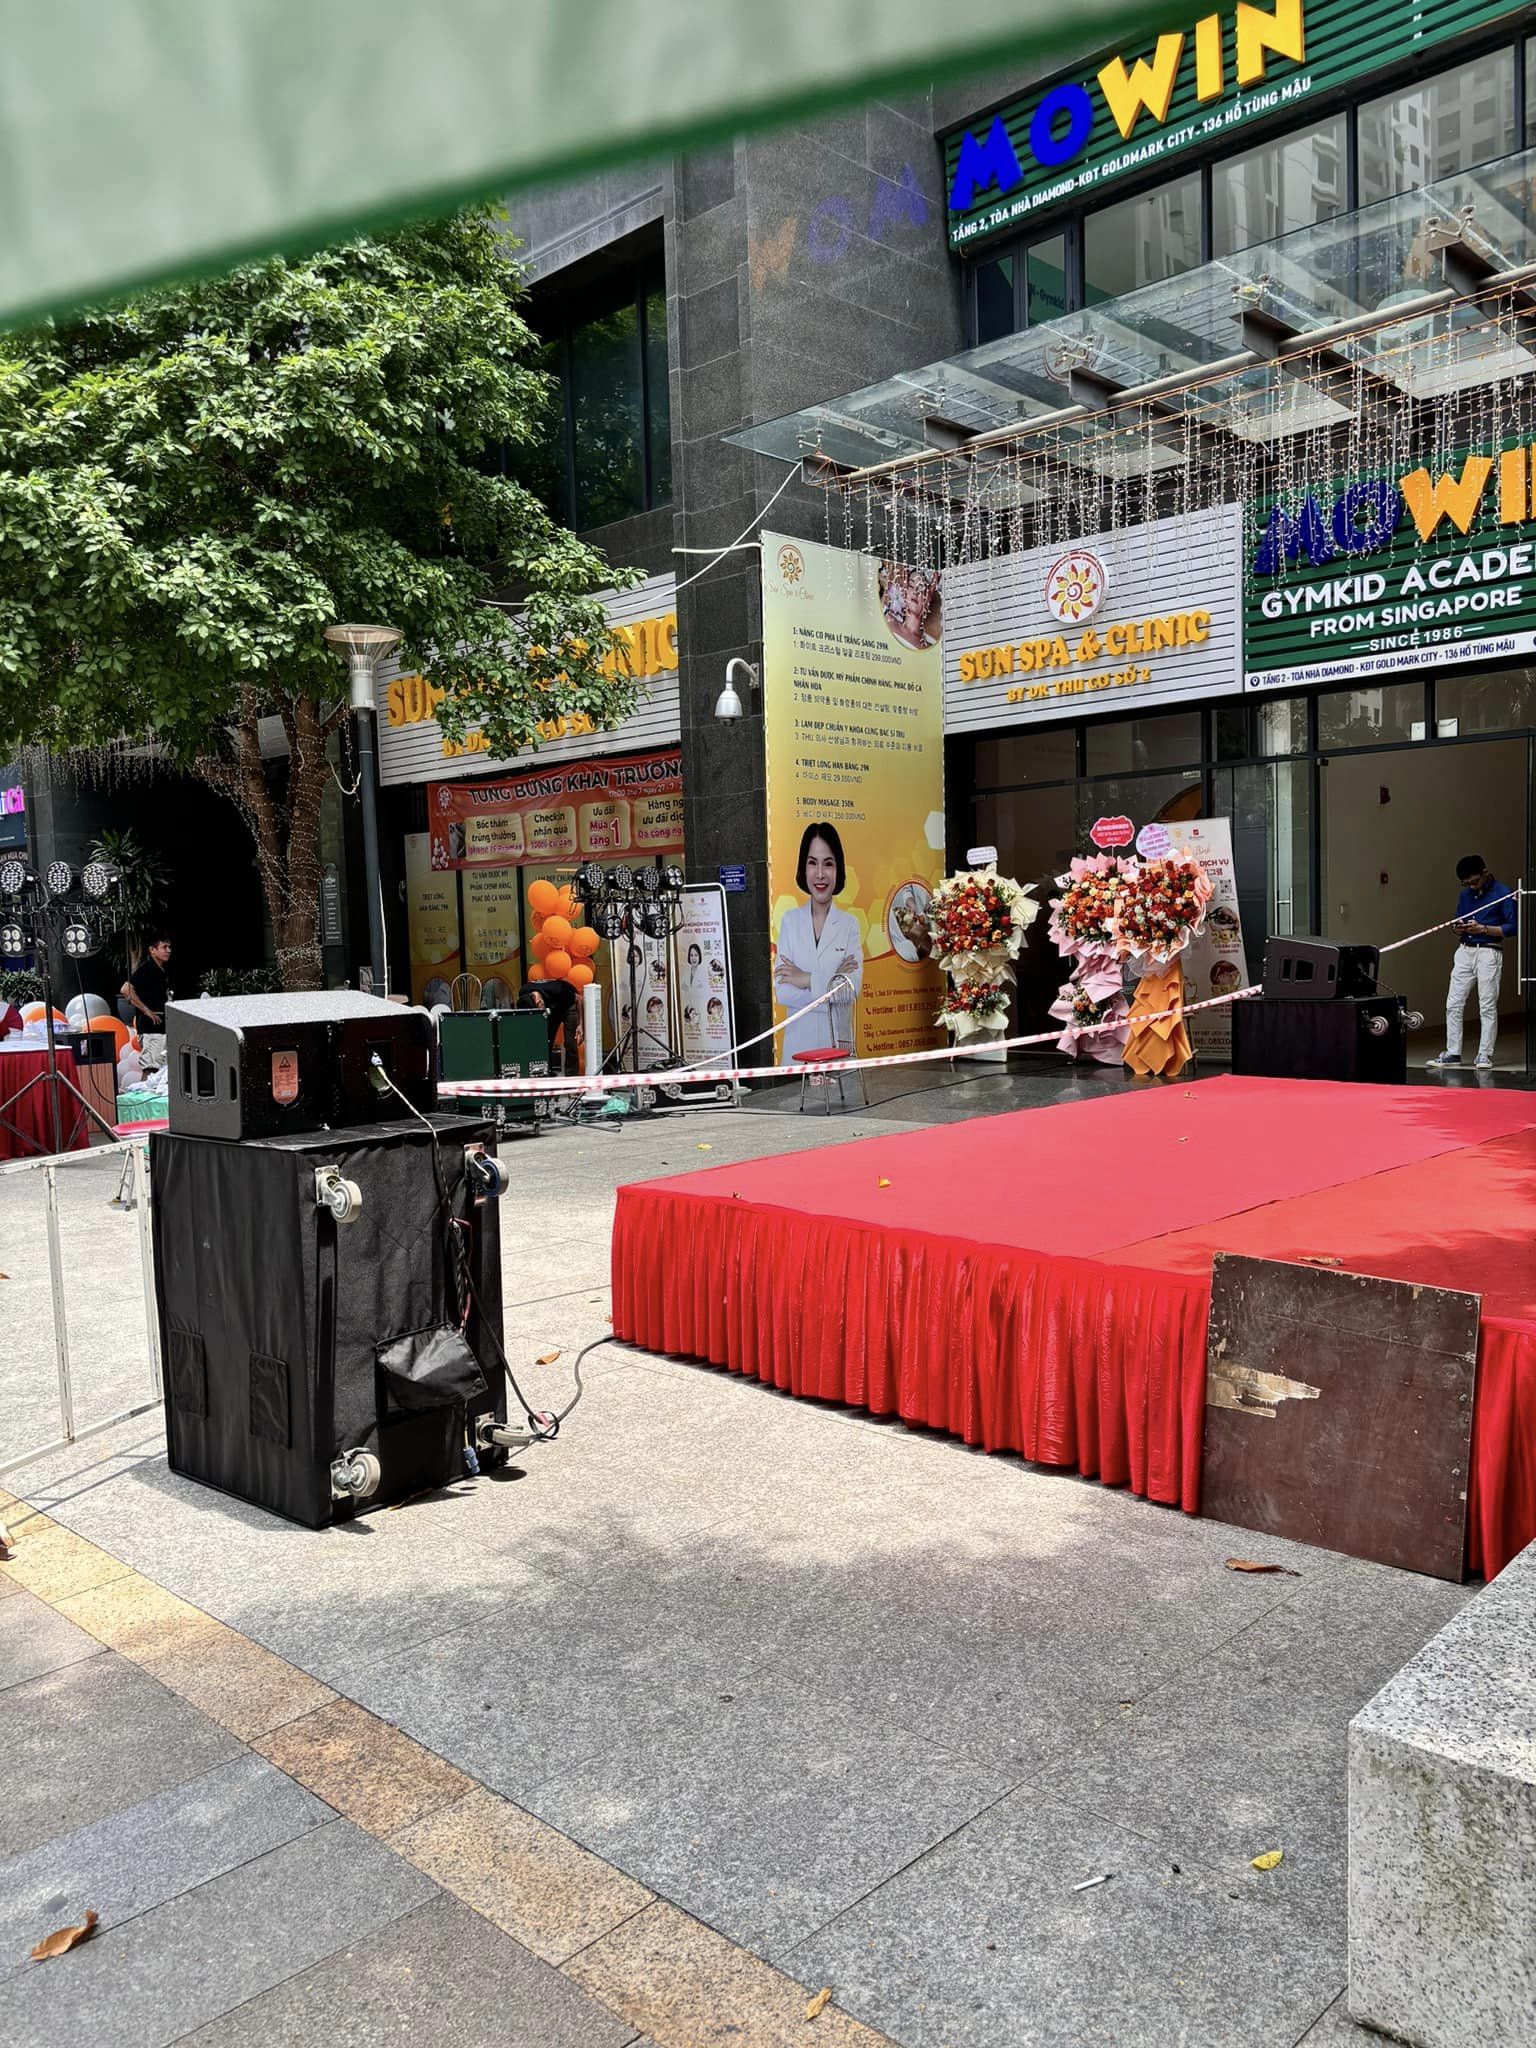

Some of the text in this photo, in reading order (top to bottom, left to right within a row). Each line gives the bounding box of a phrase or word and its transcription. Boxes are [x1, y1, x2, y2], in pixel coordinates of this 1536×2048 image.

[950, 0, 1305, 210] MOWIN
[1011, 195, 1032, 217] NHÀ
[1101, 138, 1166, 177] GOLDMARK
[1167, 124, 1195, 149] CITY
[1202, 116, 1223, 134] 136
[1244, 90, 1278, 114] TÙNG
[1281, 76, 1313, 101] MẬU
[1253, 443, 1536, 576] MOWI
[1261, 544, 1536, 619] GYMKID ACADE
[1310, 586, 1523, 639] FROM SINGAPORE
[959, 609, 1212, 685] SUN SPA & CLINIC
[1281, 673, 1286, 684] 2
[1305, 669, 1320, 680] NHÀ
[1321, 664, 1354, 678] DIAMOND
[1360, 661, 1375, 673] KĐT
[1375, 658, 1396, 670] GOLD
[1396, 654, 1420, 667] MARK
[1420, 652, 1439, 664] CITY
[1445, 649, 1458, 660] 136
[1473, 642, 1495, 656] TÙNG
[1496, 638, 1516, 654] MẬU
[1369, 626, 1463, 651] SINCE 1986
[1006, 686, 1025, 703] BY
[1029, 684, 1051, 700] DR
[1053, 677, 1084, 696] THU
[1114, 664, 1137, 686] SỞ
[566, 768, 610, 793] KHAI
[612, 758, 682, 787] TRƯƠN
[648, 800, 671, 811] Hàng
[655, 812, 668, 824] đãi
[610, 817, 622, 846] 1
